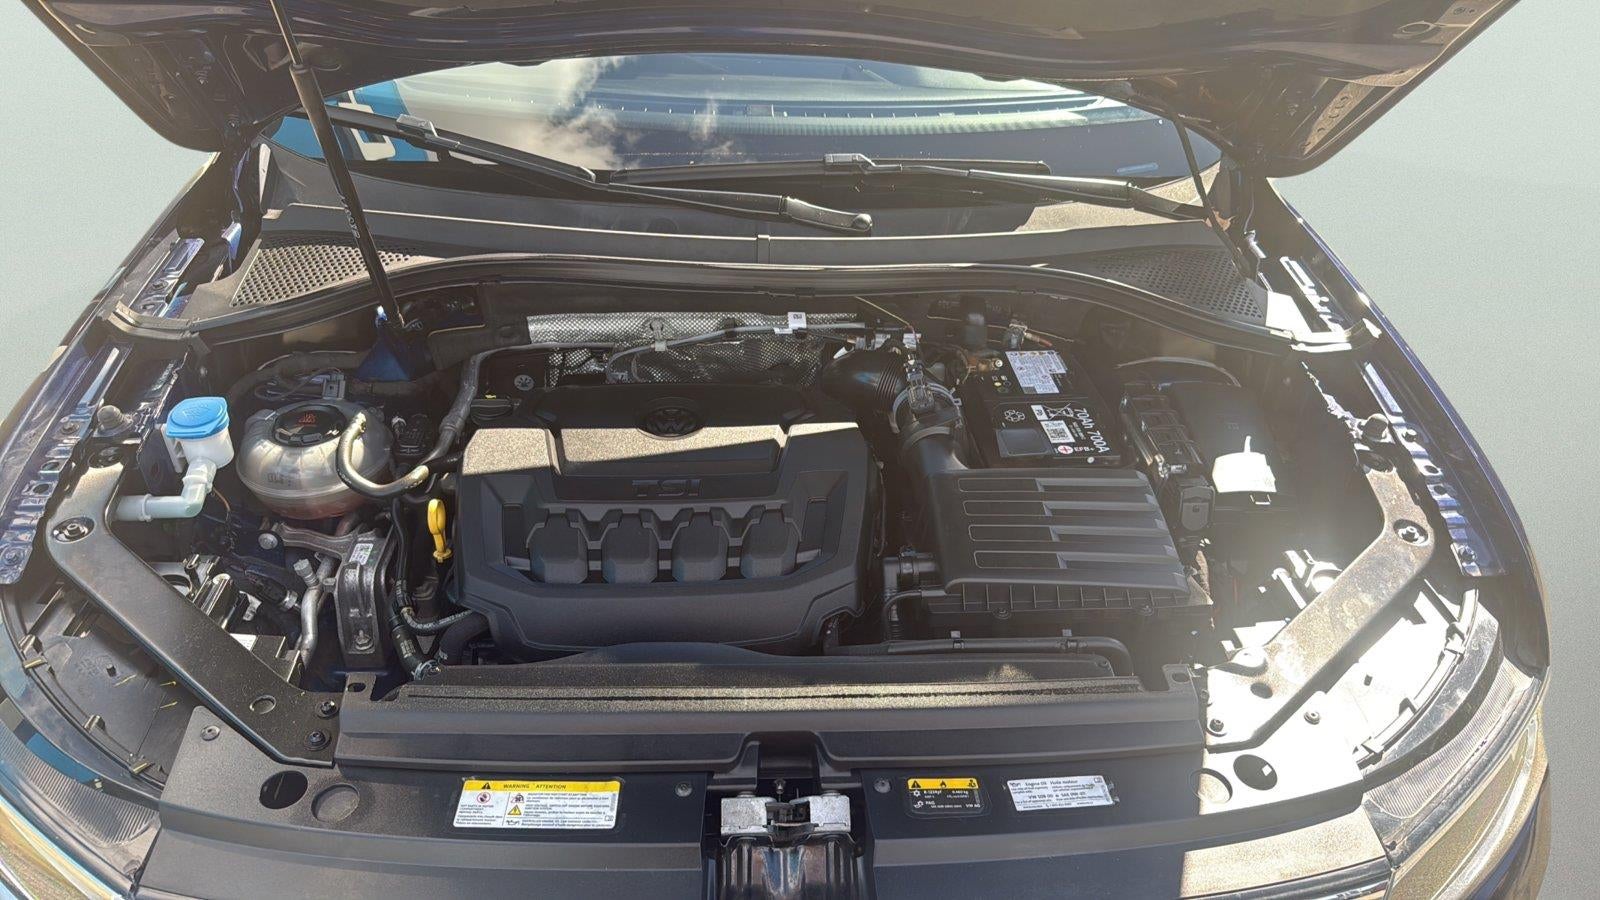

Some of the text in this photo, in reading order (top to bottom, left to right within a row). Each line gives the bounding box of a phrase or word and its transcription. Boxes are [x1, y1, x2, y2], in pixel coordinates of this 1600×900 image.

[1074, 408, 1095, 429] 70Ah
[1087, 430, 1110, 453] 700A
[632, 479, 701, 497] TSI
